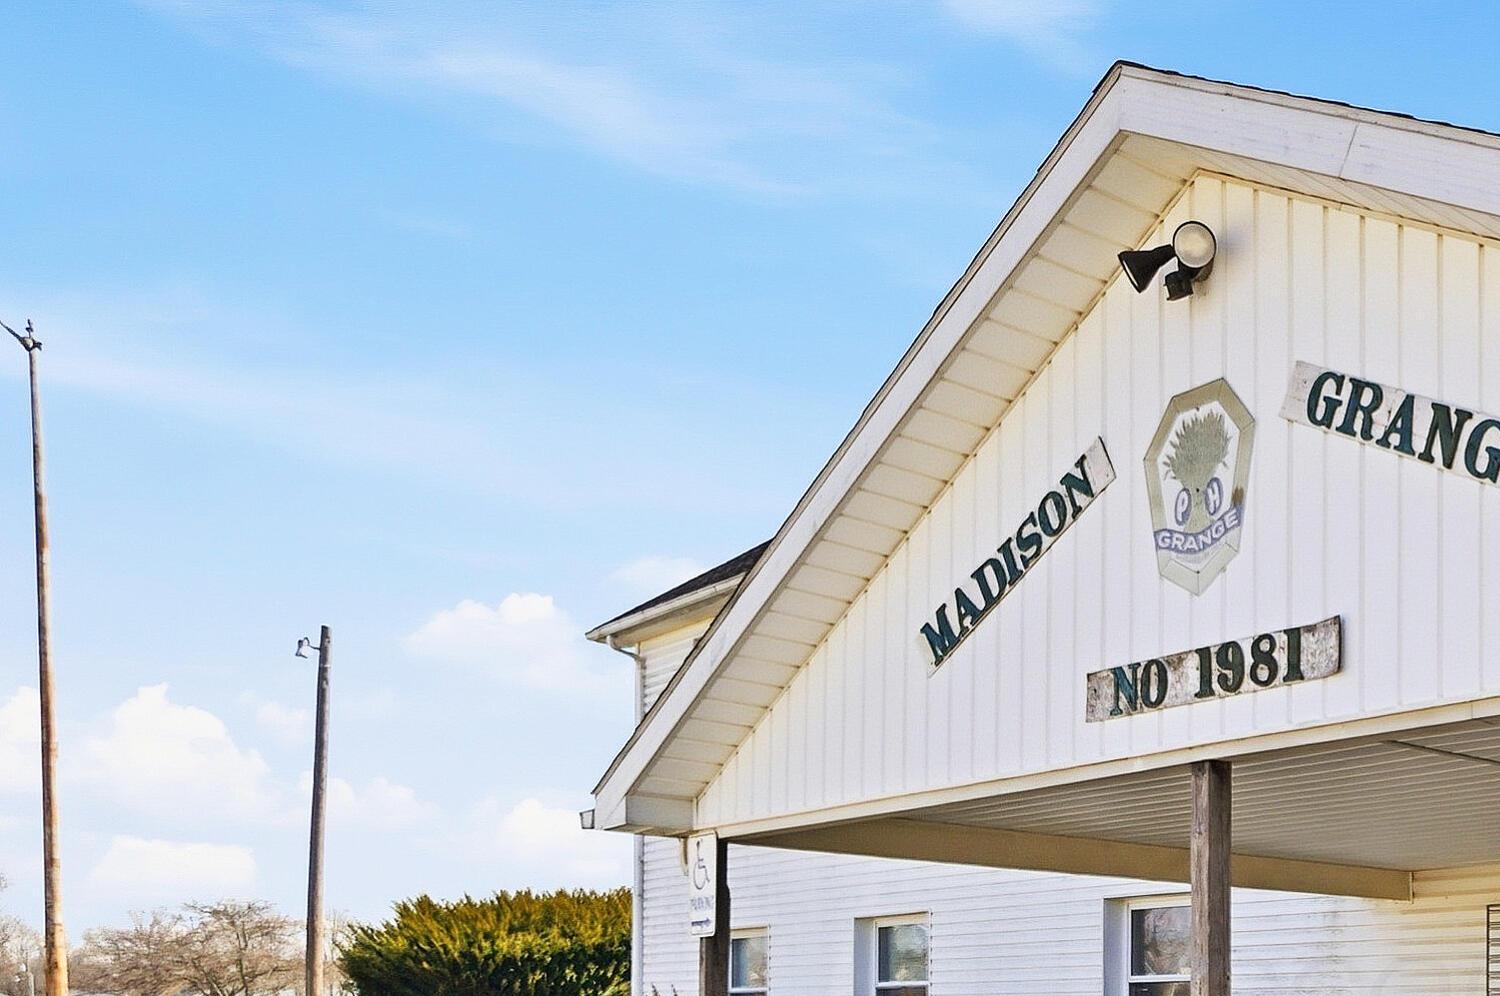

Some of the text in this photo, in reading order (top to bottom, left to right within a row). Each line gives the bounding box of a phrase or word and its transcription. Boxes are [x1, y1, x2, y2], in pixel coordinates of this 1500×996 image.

[1158, 508, 1239, 551] GRANGE
[1176, 480, 1221, 522] P H
[919, 453, 1095, 667] MADISON
[1109, 627, 1305, 717] NO 1981
